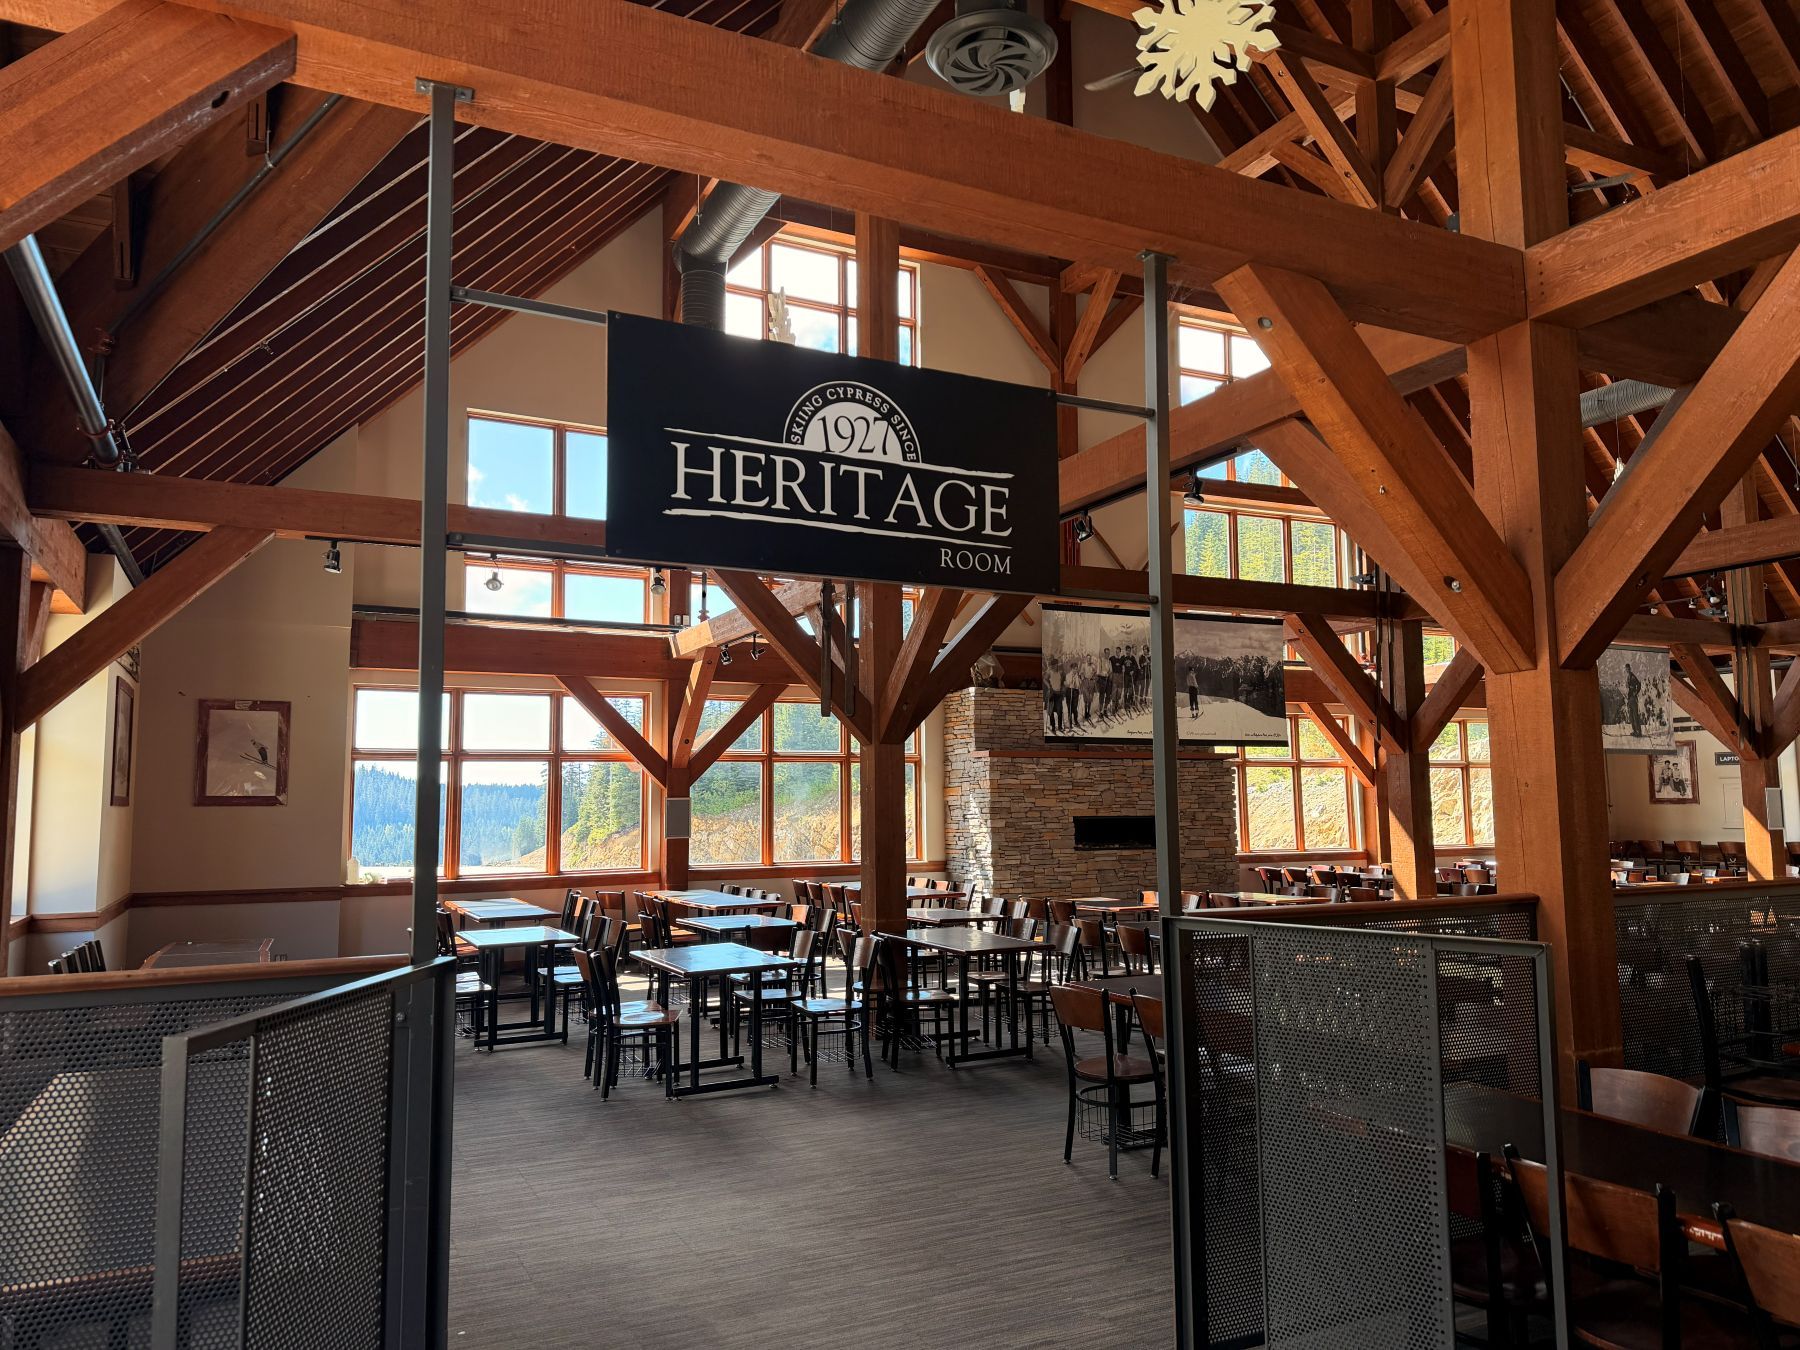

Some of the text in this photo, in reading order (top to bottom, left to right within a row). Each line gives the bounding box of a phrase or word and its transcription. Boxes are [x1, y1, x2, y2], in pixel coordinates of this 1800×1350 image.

[790, 387, 916, 461] SKIING CYPRESS SINCE
[817, 415, 890, 456] 1927
[670, 441, 1013, 537] HERITAGE
[940, 548, 1012, 575] ROOM
